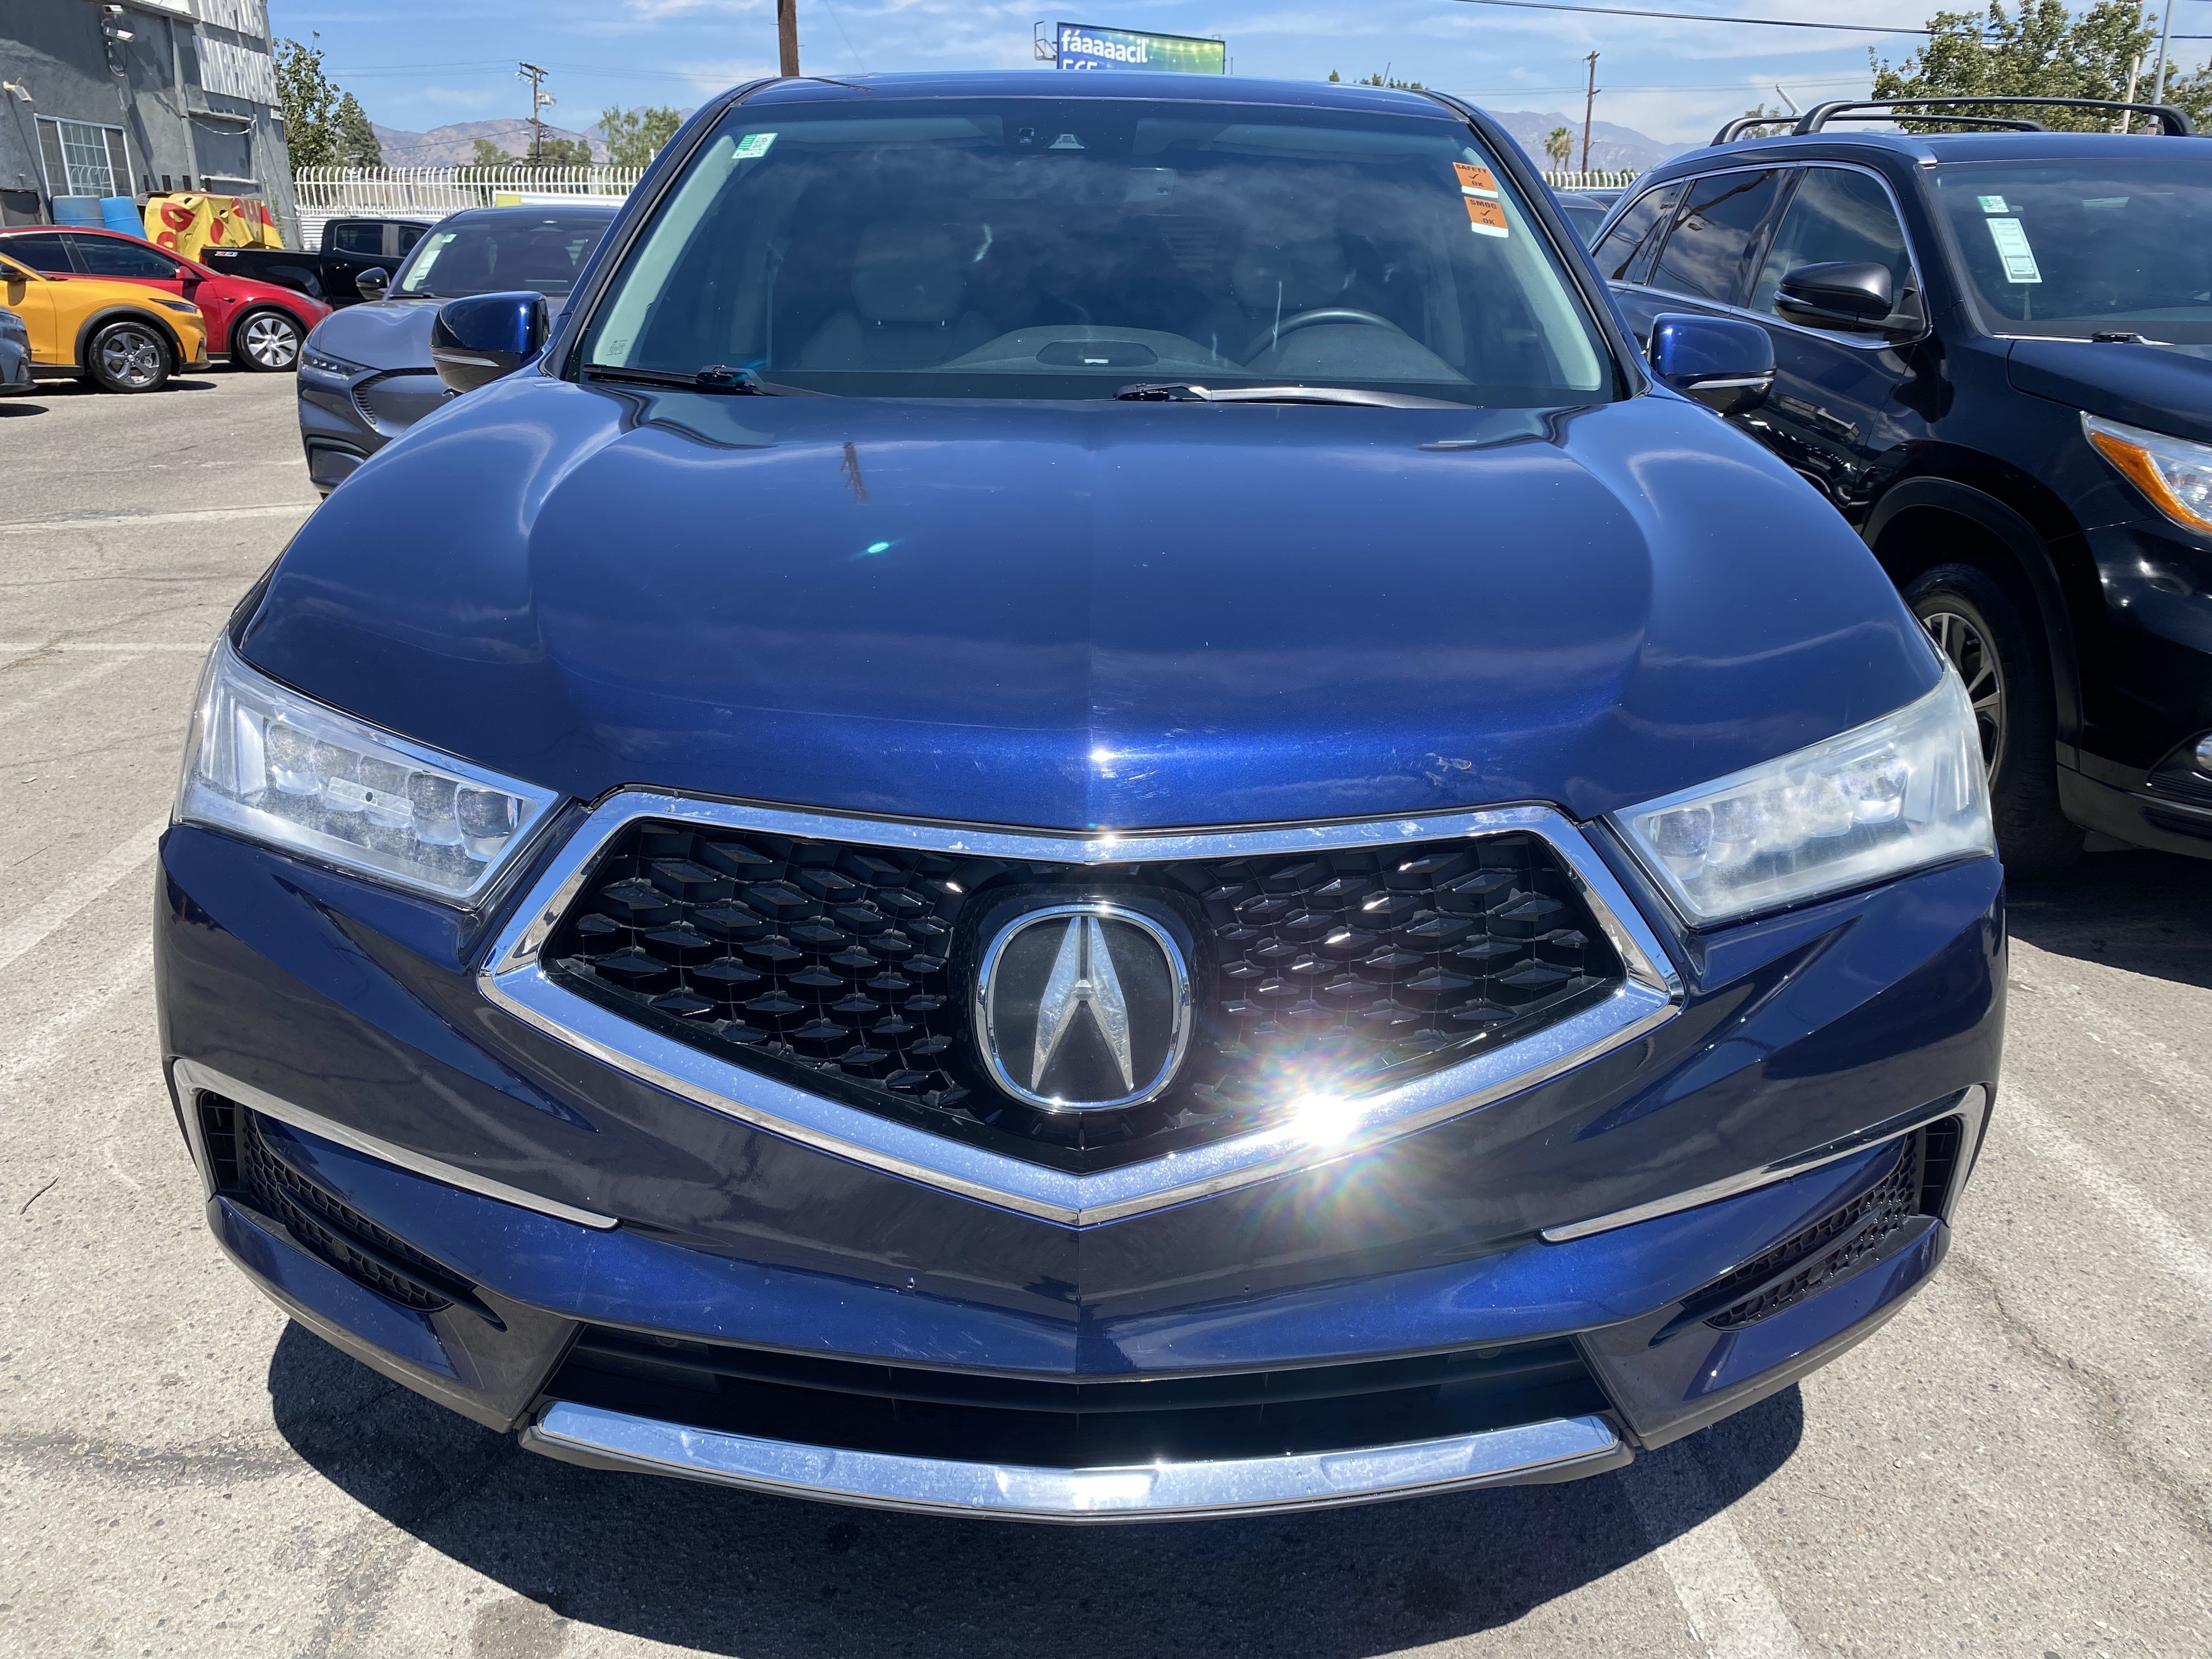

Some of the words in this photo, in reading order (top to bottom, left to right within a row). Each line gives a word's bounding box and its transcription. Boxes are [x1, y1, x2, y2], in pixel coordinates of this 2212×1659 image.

[192, 35, 282, 106] WAREHOUSE
[1455, 165, 1487, 173] SAFETY
[1470, 199, 1497, 209] SMOG
